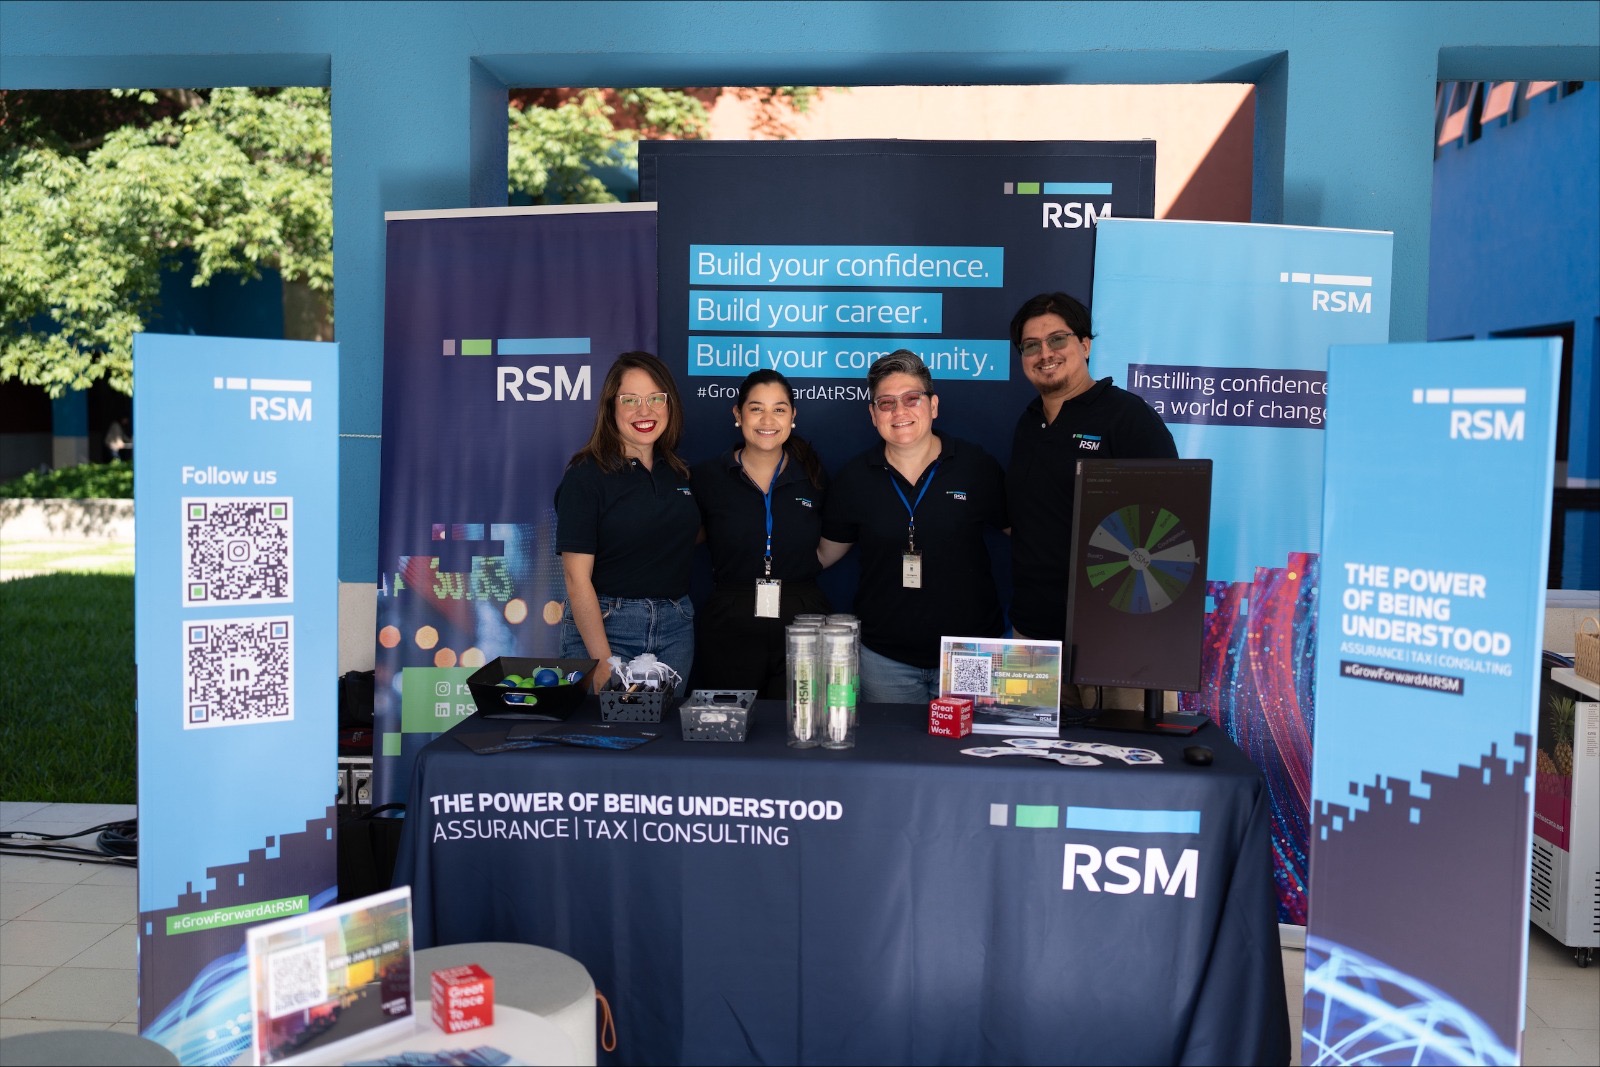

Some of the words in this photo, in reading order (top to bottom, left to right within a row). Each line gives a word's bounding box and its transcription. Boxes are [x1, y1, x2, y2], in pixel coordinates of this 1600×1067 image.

[698, 251, 761, 276] Build
[769, 258, 829, 283] your
[836, 253, 989, 278] confidence.
[697, 297, 760, 322] Build
[768, 305, 829, 329] your
[836, 305, 927, 324] career.
[1312, 290, 1372, 313] RSM
[697, 343, 760, 368] Build
[767, 350, 828, 371] your
[497, 365, 591, 402] RSM
[1134, 371, 1216, 396] Instilling
[250, 397, 312, 421] RSM
[1154, 401, 1165, 414] a
[1171, 399, 1228, 417] world
[1233, 400, 1255, 417] of
[1450, 410, 1525, 440] RSM
[1079, 440, 1100, 451] RSM
[182, 466, 249, 485] Follow
[253, 470, 277, 485] us
[1344, 563, 1390, 588] THE
[1393, 568, 1487, 599] POWER
[1342, 589, 1375, 611] OF
[1377, 592, 1451, 621] BEING
[1341, 614, 1511, 657] UNDERSTOOD
[1340, 641, 1404, 661] ASSURANCE
[1411, 651, 1433, 666] TAX
[1438, 655, 1513, 677] CONSULTING
[1344, 664, 1460, 692] #GrowForwardAtRSM
[799, 680, 809, 705] RSM
[931, 703, 954, 713] Great
[931, 711, 953, 720] Place
[931, 718, 940, 726] To
[931, 726, 953, 735] Work.
[429, 793, 475, 815] THE
[478, 792, 564, 813] POWER
[568, 792, 599, 812] OF
[603, 794, 673, 816] BEING
[678, 796, 843, 820] UNDERSTOOD
[433, 818, 569, 843] ASSURANCE
[584, 819, 628, 840] TAX
[642, 822, 789, 846] CONSULTING
[1062, 843, 1199, 899] RSM
[173, 899, 303, 930] #GrowForwardAtRSM
[448, 983, 484, 998] Great
[449, 995, 485, 1009] Place
[449, 1009, 464, 1020] To
